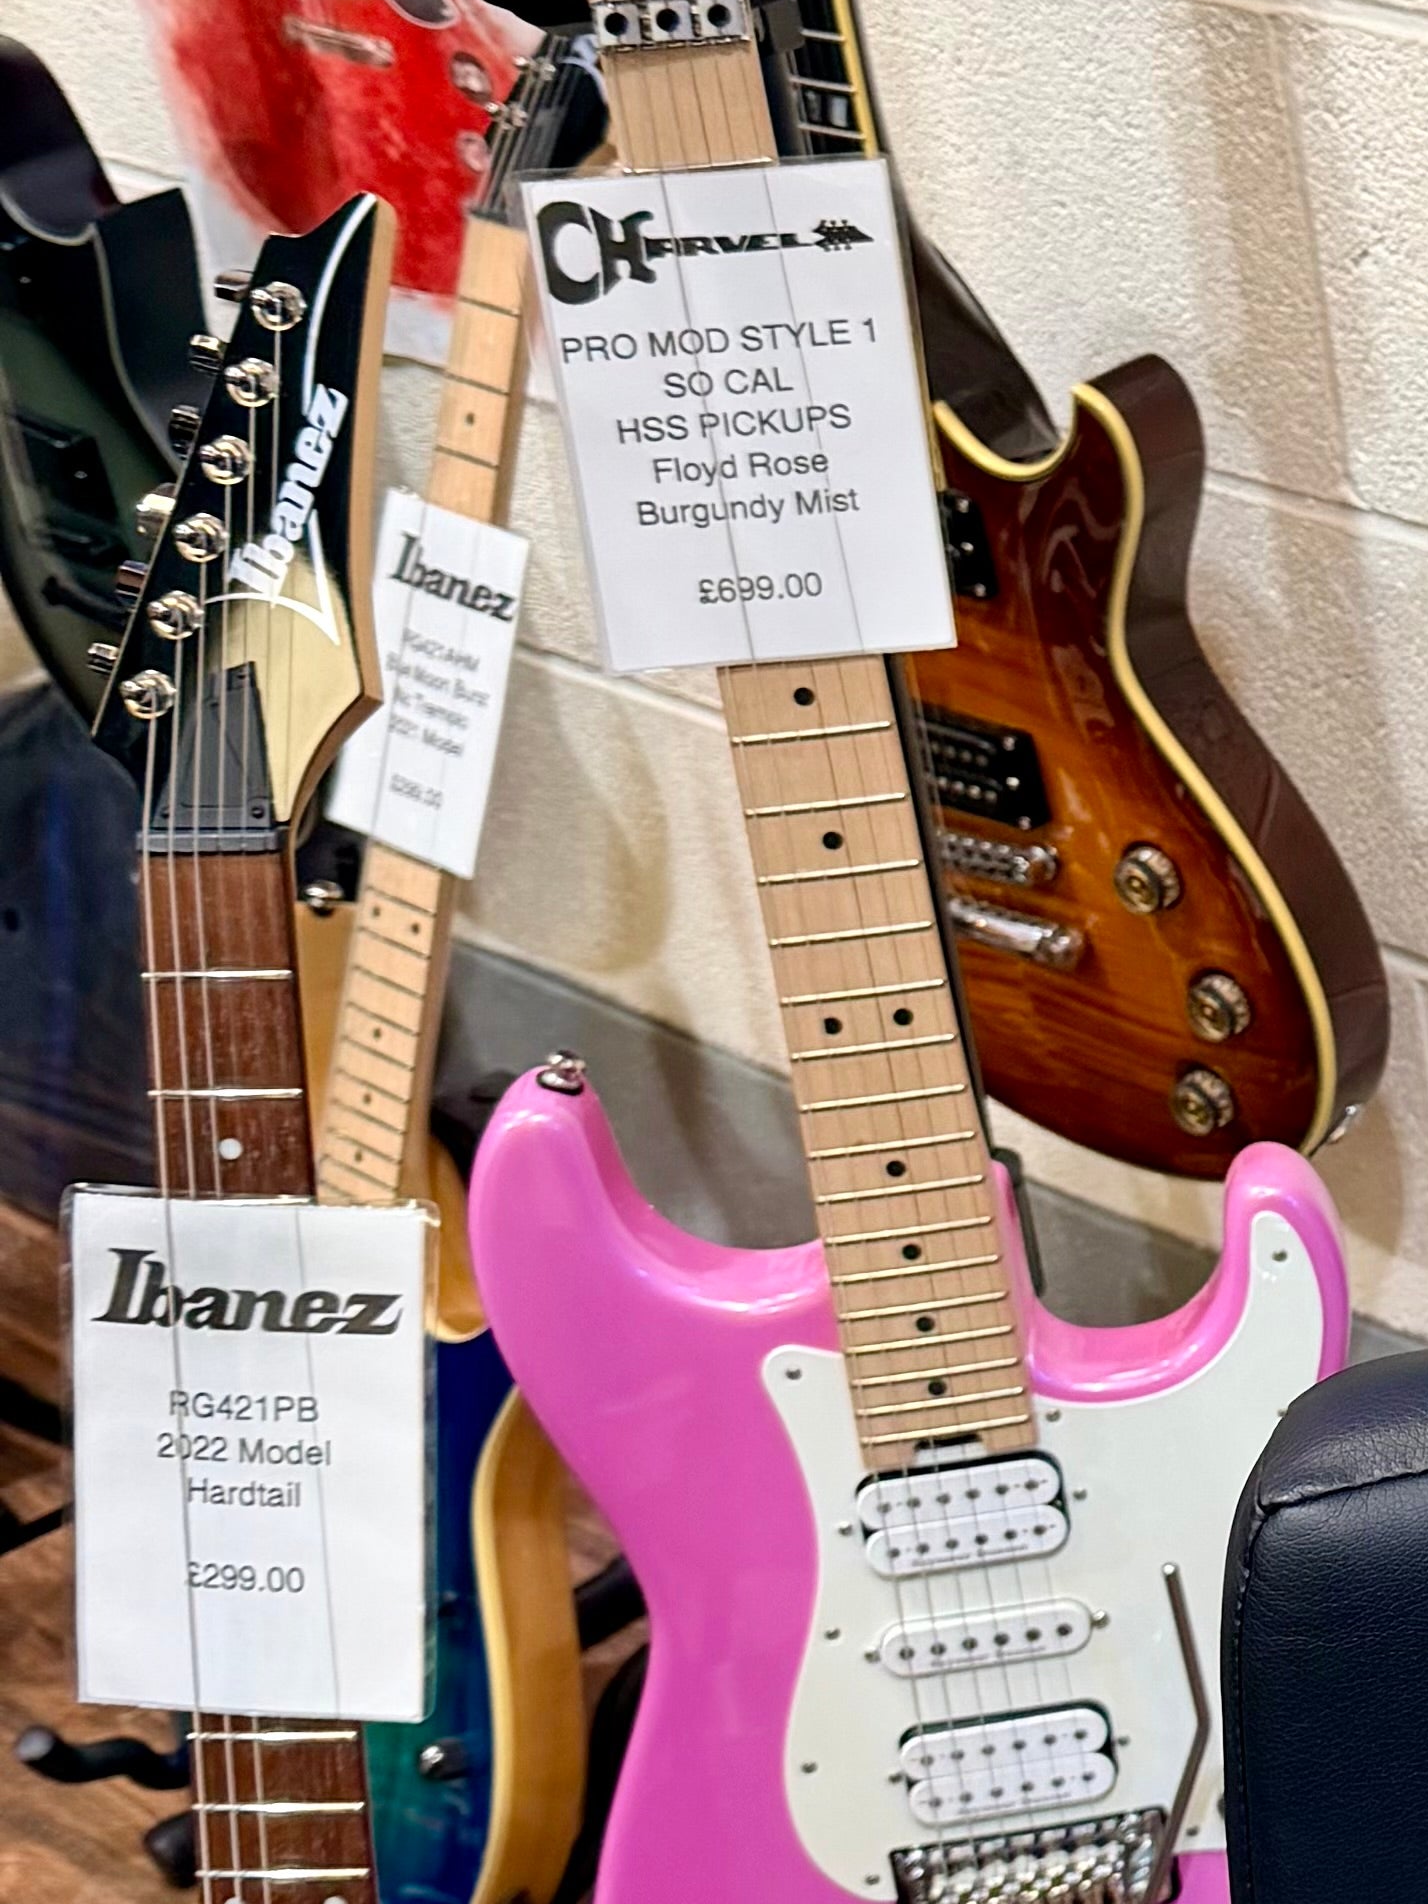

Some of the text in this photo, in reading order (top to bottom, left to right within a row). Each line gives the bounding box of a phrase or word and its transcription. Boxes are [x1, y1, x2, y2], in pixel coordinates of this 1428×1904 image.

[561, 318, 877, 364] PRO MOD STYLE 1
[663, 367, 794, 399] SO CAL
[617, 404, 852, 444] HSS PICKUPS
[652, 451, 830, 489] Floyd Rose
[228, 383, 350, 597] Ibanez
[637, 489, 861, 528] Burgundy Mist
[387, 531, 517, 623] Ibanez
[698, 571, 824, 604] £699.00
[91, 1246, 404, 1337] Ibanez
[169, 1389, 320, 1423] RG421PB
[156, 1432, 332, 1467] 2022 Model
[186, 1477, 303, 1509] Hardtail
[186, 1561, 306, 1593] £299.00
